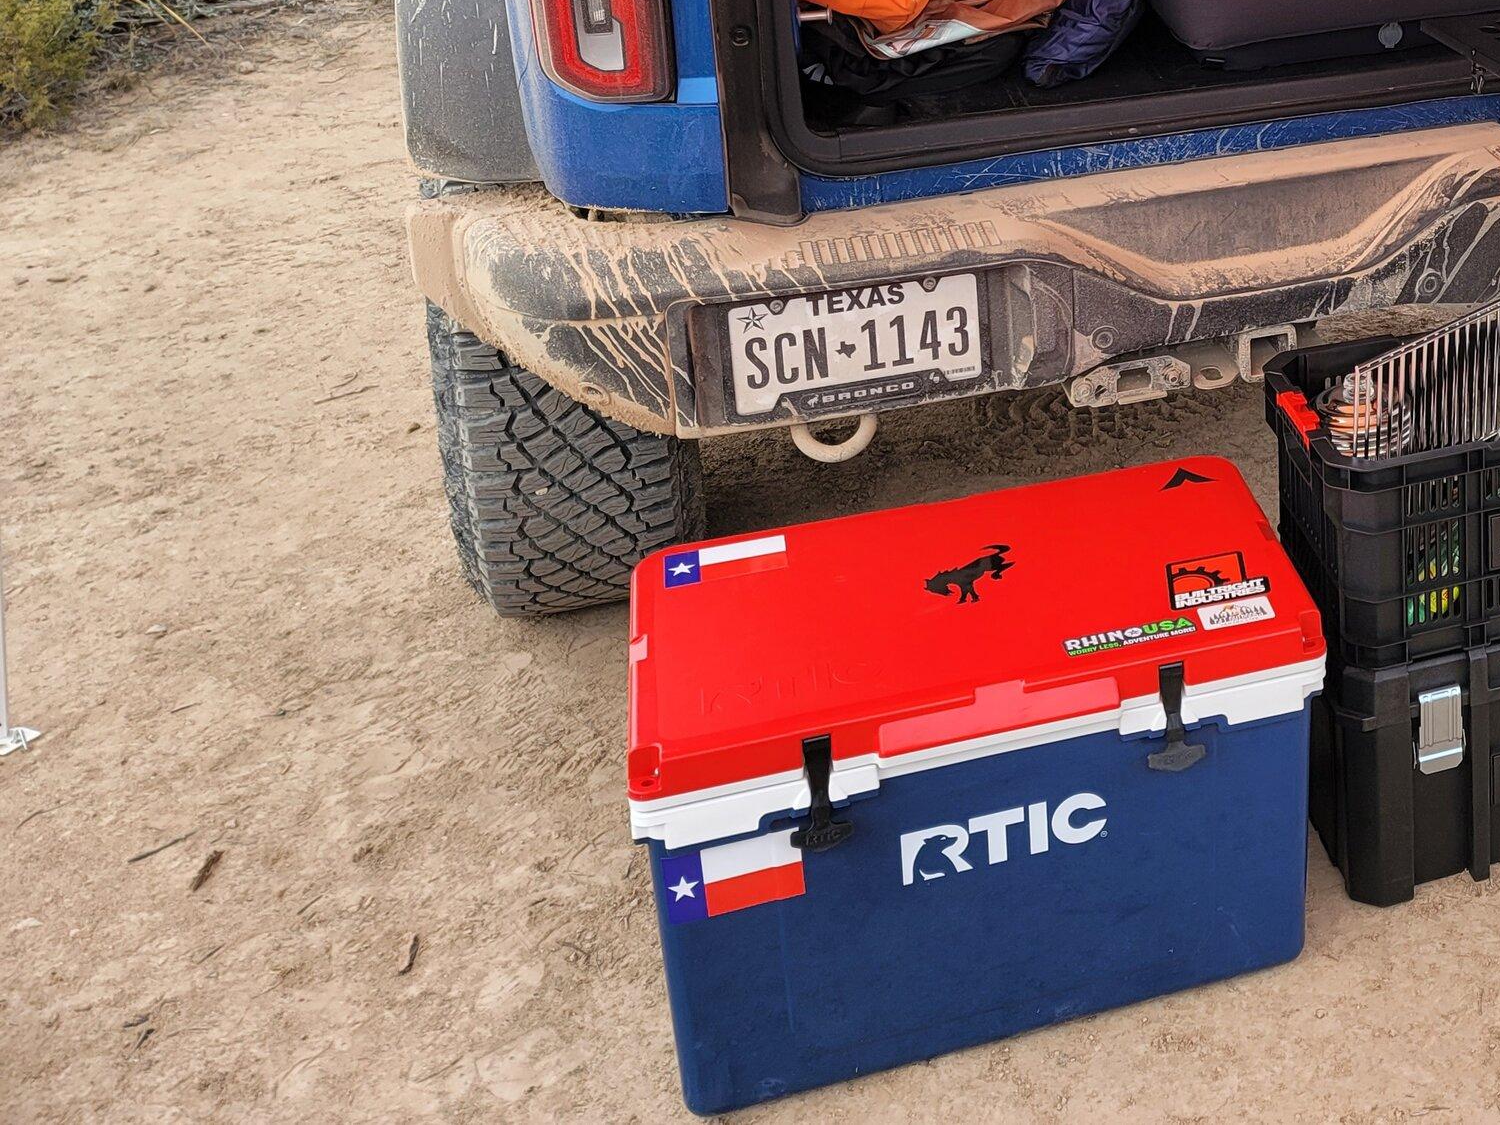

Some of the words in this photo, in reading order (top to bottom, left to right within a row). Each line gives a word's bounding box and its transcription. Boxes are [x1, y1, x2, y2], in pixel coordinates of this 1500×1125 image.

[806, 284, 905, 317] TEXAS
[744, 327, 829, 390] SCN
[860, 305, 970, 372] 1143
[821, 380, 915, 404] BRONCO
[1174, 578, 1265, 602] BUILTRIGHT
[1175, 586, 1266, 609] INDUSTRIES
[1068, 646, 1098, 656] WORRY
[1123, 631, 1170, 646] ADVENTURE
[1170, 626, 1196, 637] MORE!
[899, 792, 1108, 886] RTIC
